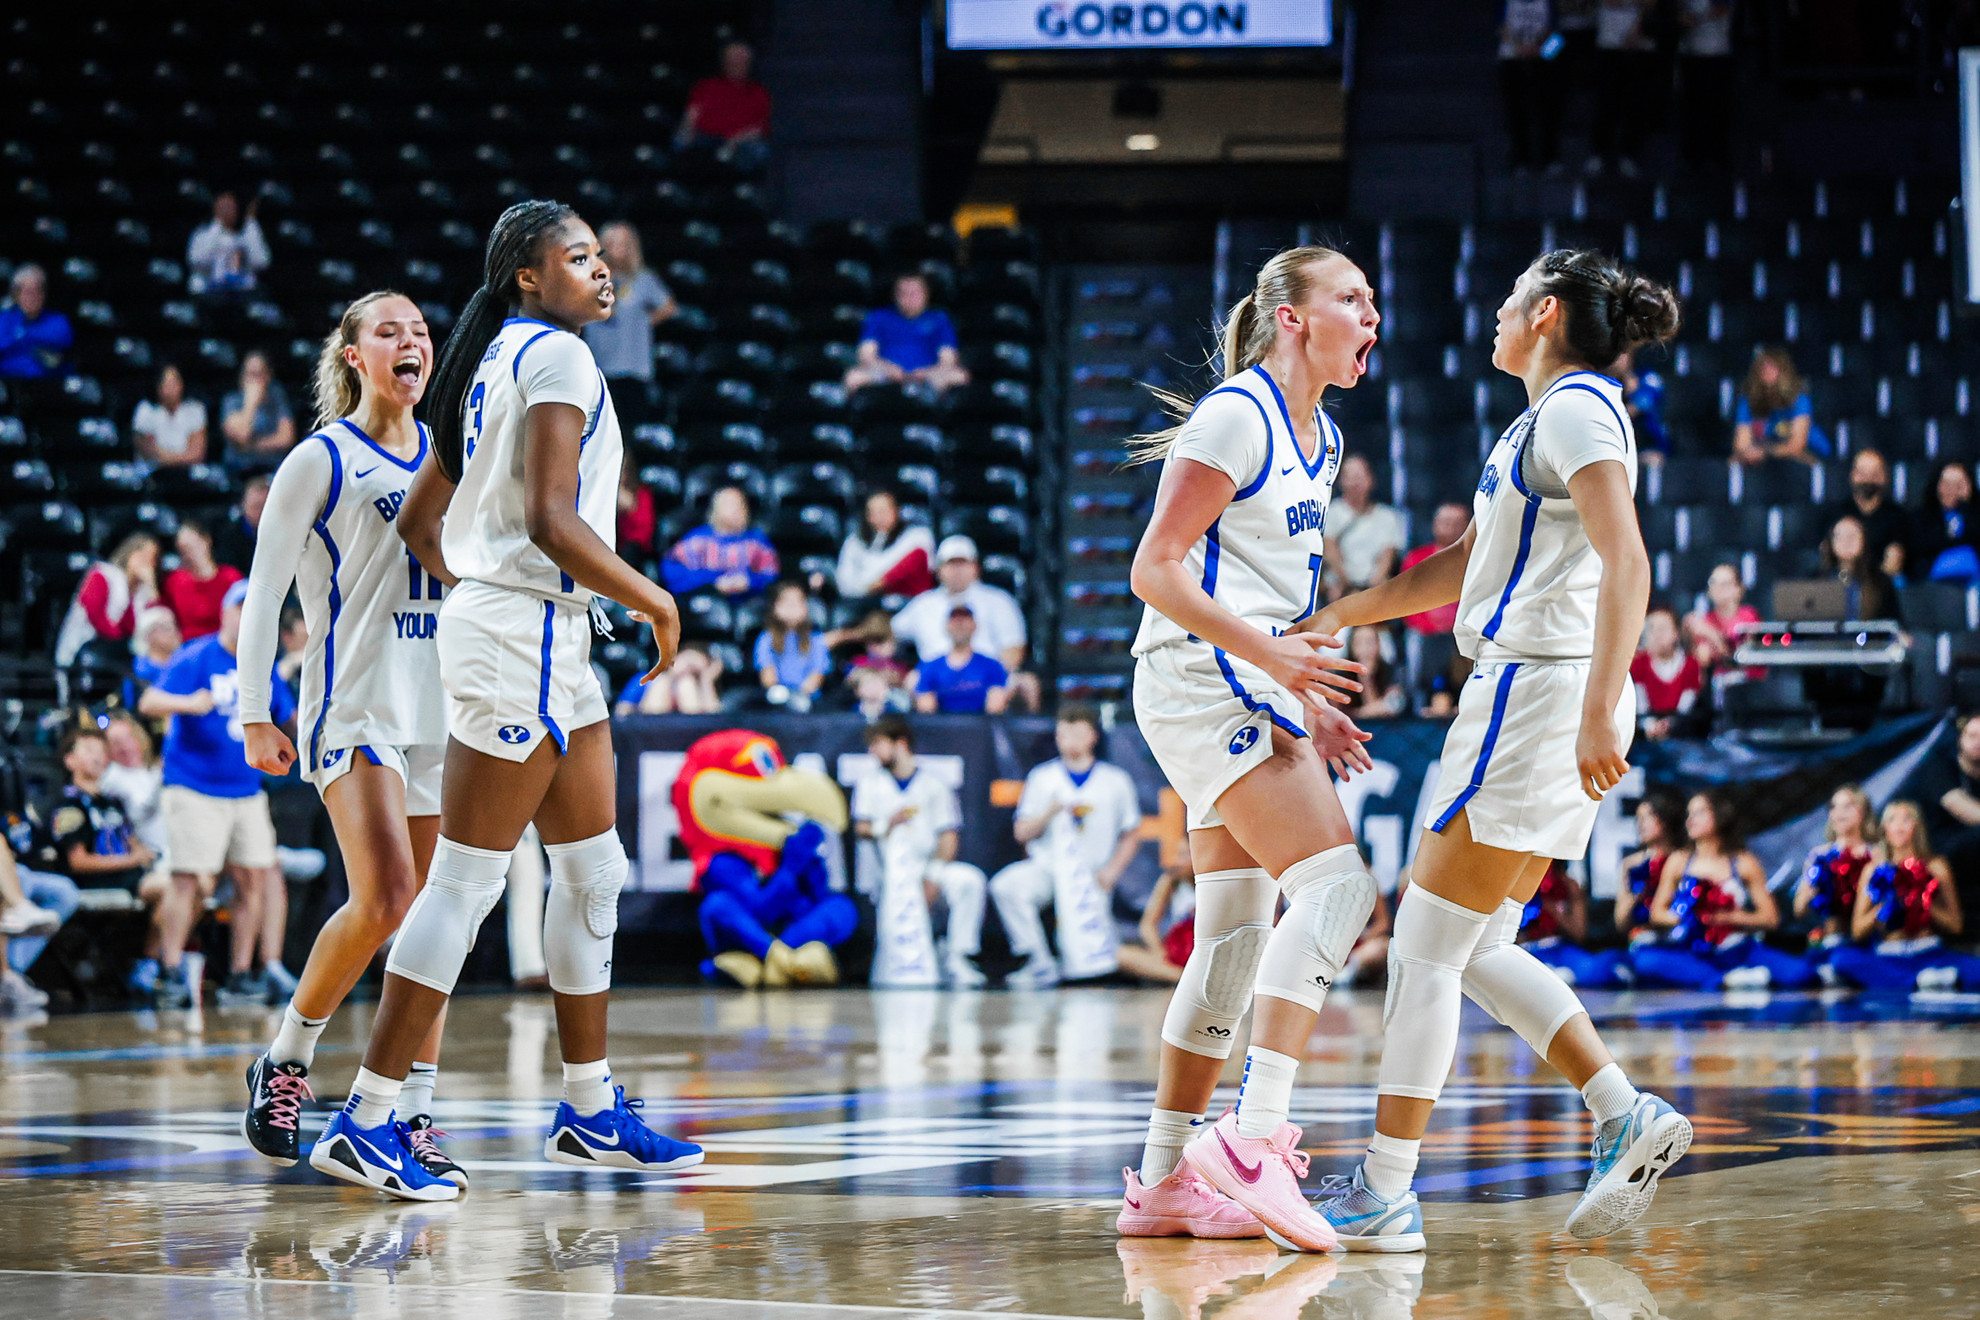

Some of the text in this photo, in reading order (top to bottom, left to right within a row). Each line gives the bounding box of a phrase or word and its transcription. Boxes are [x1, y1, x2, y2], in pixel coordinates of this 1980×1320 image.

[1038, 4, 1244, 37] GORDON
[374, 489, 406, 523] BR
[503, 726, 527, 743] Y
